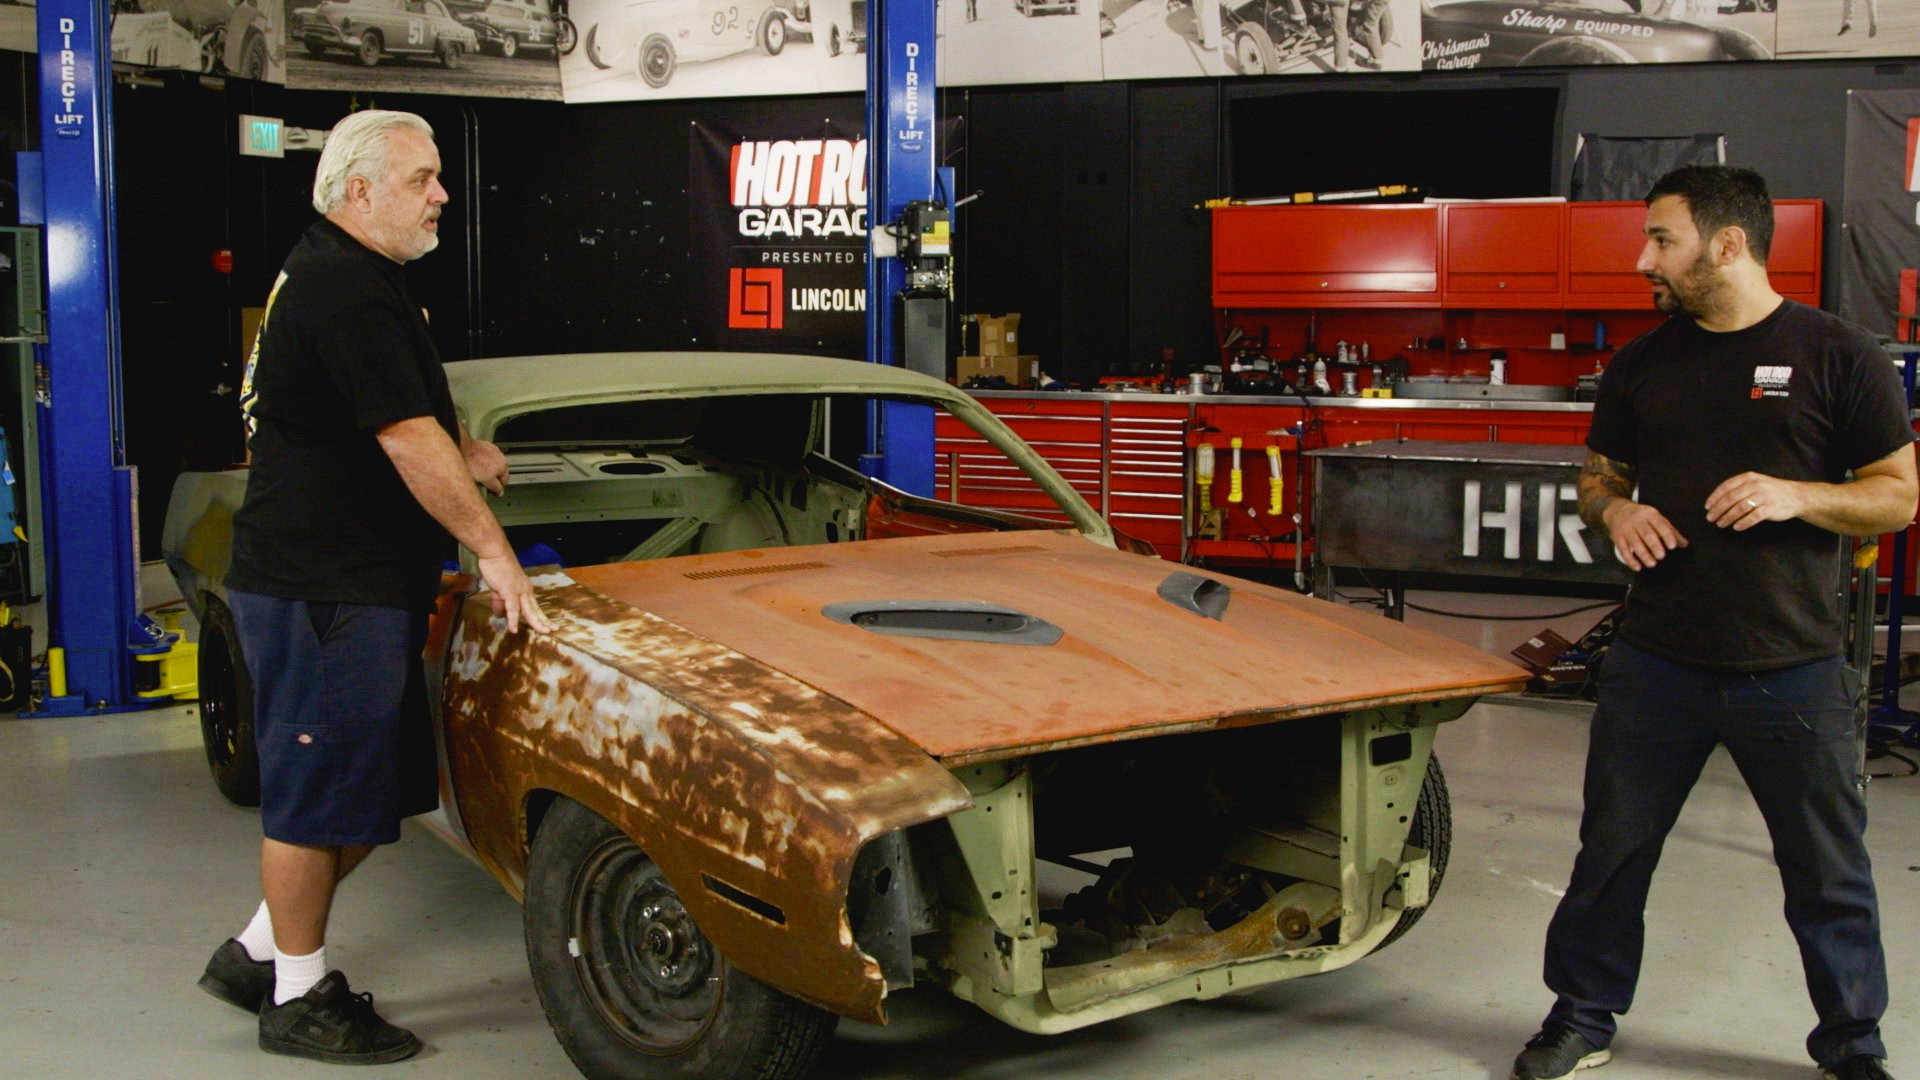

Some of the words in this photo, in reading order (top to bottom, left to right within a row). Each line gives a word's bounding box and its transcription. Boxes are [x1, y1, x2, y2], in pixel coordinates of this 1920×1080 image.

[408, 20, 423, 45] 51
[711, 6, 738, 36] 92
[1503, 8, 1567, 33] Sharp
[1573, 19, 1654, 38] EQUIPPED
[1421, 32, 1490, 61] Chrisman's
[60, 18, 75, 113] DIRECT
[1436, 53, 1481, 71] Garage
[906, 42, 919, 130] DIRECT
[54, 114, 84, 125] LIFT
[251, 121, 280, 152] EXIT
[899, 130, 924, 141] LIFT
[733, 140, 822, 207] HOT
[817, 139, 867, 206] RO
[739, 208, 867, 236] GARAG
[762, 251, 855, 263] PRESENTED
[791, 287, 867, 312] LINCOLN
